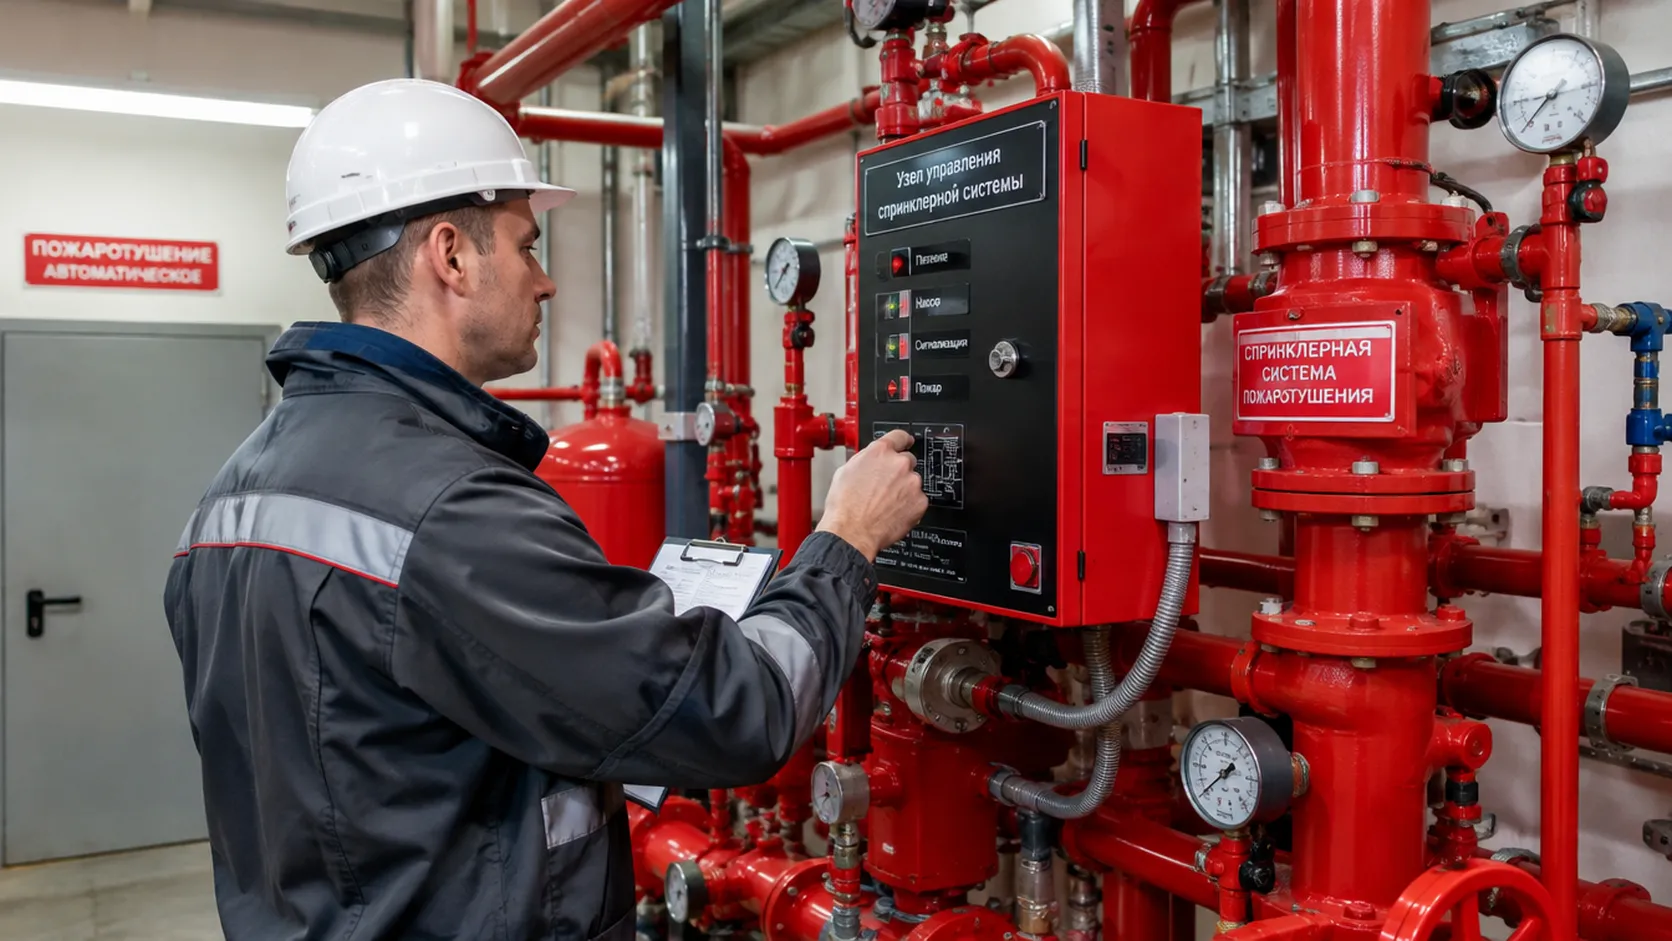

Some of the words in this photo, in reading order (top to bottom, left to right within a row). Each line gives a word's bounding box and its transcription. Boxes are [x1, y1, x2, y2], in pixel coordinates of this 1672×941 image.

[896, 171, 924, 188] Узел
[926, 148, 1001, 185] управления
[877, 183, 959, 220] спринклерной
[963, 174, 1024, 200] системы
[32, 239, 213, 264] ПОЖАРОТУШЕНИЕ
[43, 263, 202, 284] АВТОМАТИЧЕСКОЕ
[1245, 340, 1372, 360] СПРИНКЛЕРНАЯ
[1262, 365, 1336, 382] СИСТЕМА
[1243, 388, 1374, 404] ПОЖАРОТУШЕНИЯ
